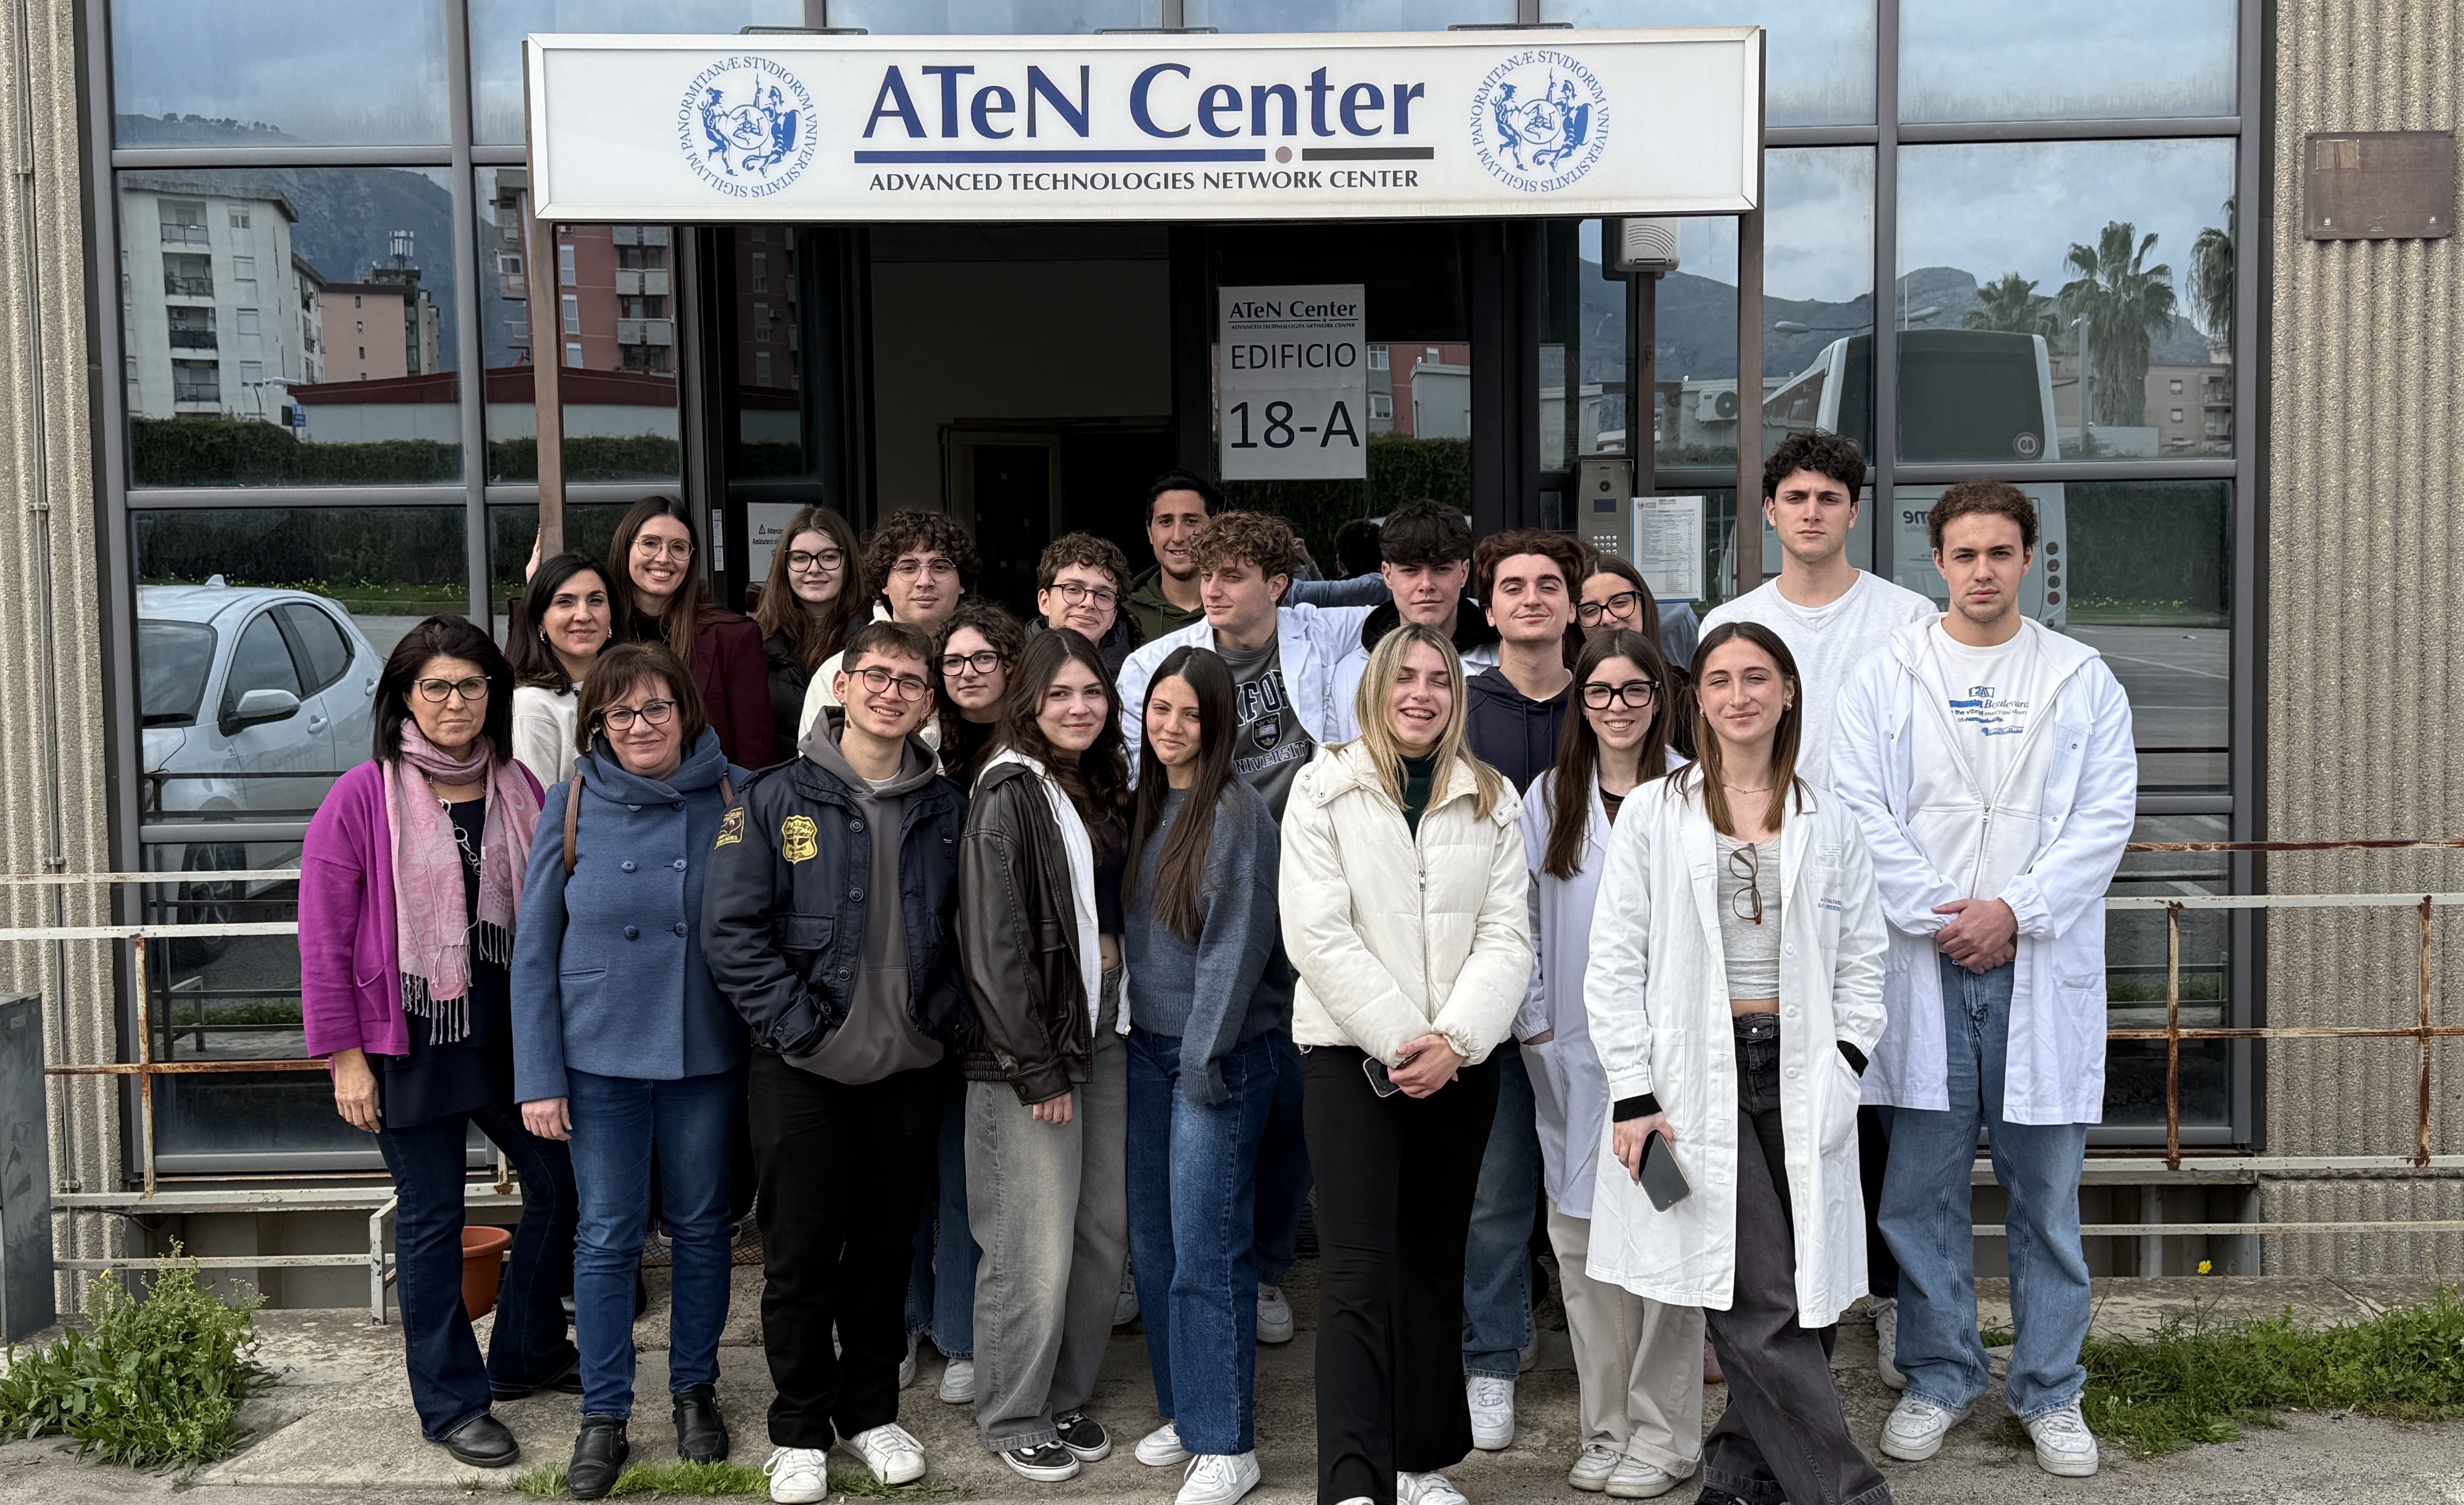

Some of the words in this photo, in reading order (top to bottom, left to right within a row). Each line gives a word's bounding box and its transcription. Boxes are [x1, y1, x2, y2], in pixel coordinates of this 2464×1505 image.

[678, 57, 740, 151] PANORMITANÆ
[744, 56, 814, 112] STVDIORVM
[862, 65, 1089, 139] ATeN
[1130, 63, 1424, 138] Center
[1471, 51, 1535, 146] PANORMITANÆ
[1538, 50, 1606, 105] STVDIORVM
[686, 152, 748, 198] SIGILLVM
[751, 114, 817, 198] VNIVERSITATIS
[1476, 148, 1537, 192] SIGILLVM
[1541, 106, 1609, 192] VNIVERSITATIS
[870, 173, 1002, 190] ADVANCED
[1008, 172, 1194, 190] TECHNOLOGIES
[1204, 171, 1322, 189] NETWORK
[1330, 170, 1418, 188] CENTER
[1230, 301, 1281, 318] ATeN
[1289, 301, 1356, 317] Center
[1232, 342, 1356, 369] EDIFICIO
[1231, 401, 1359, 448] 18-A
